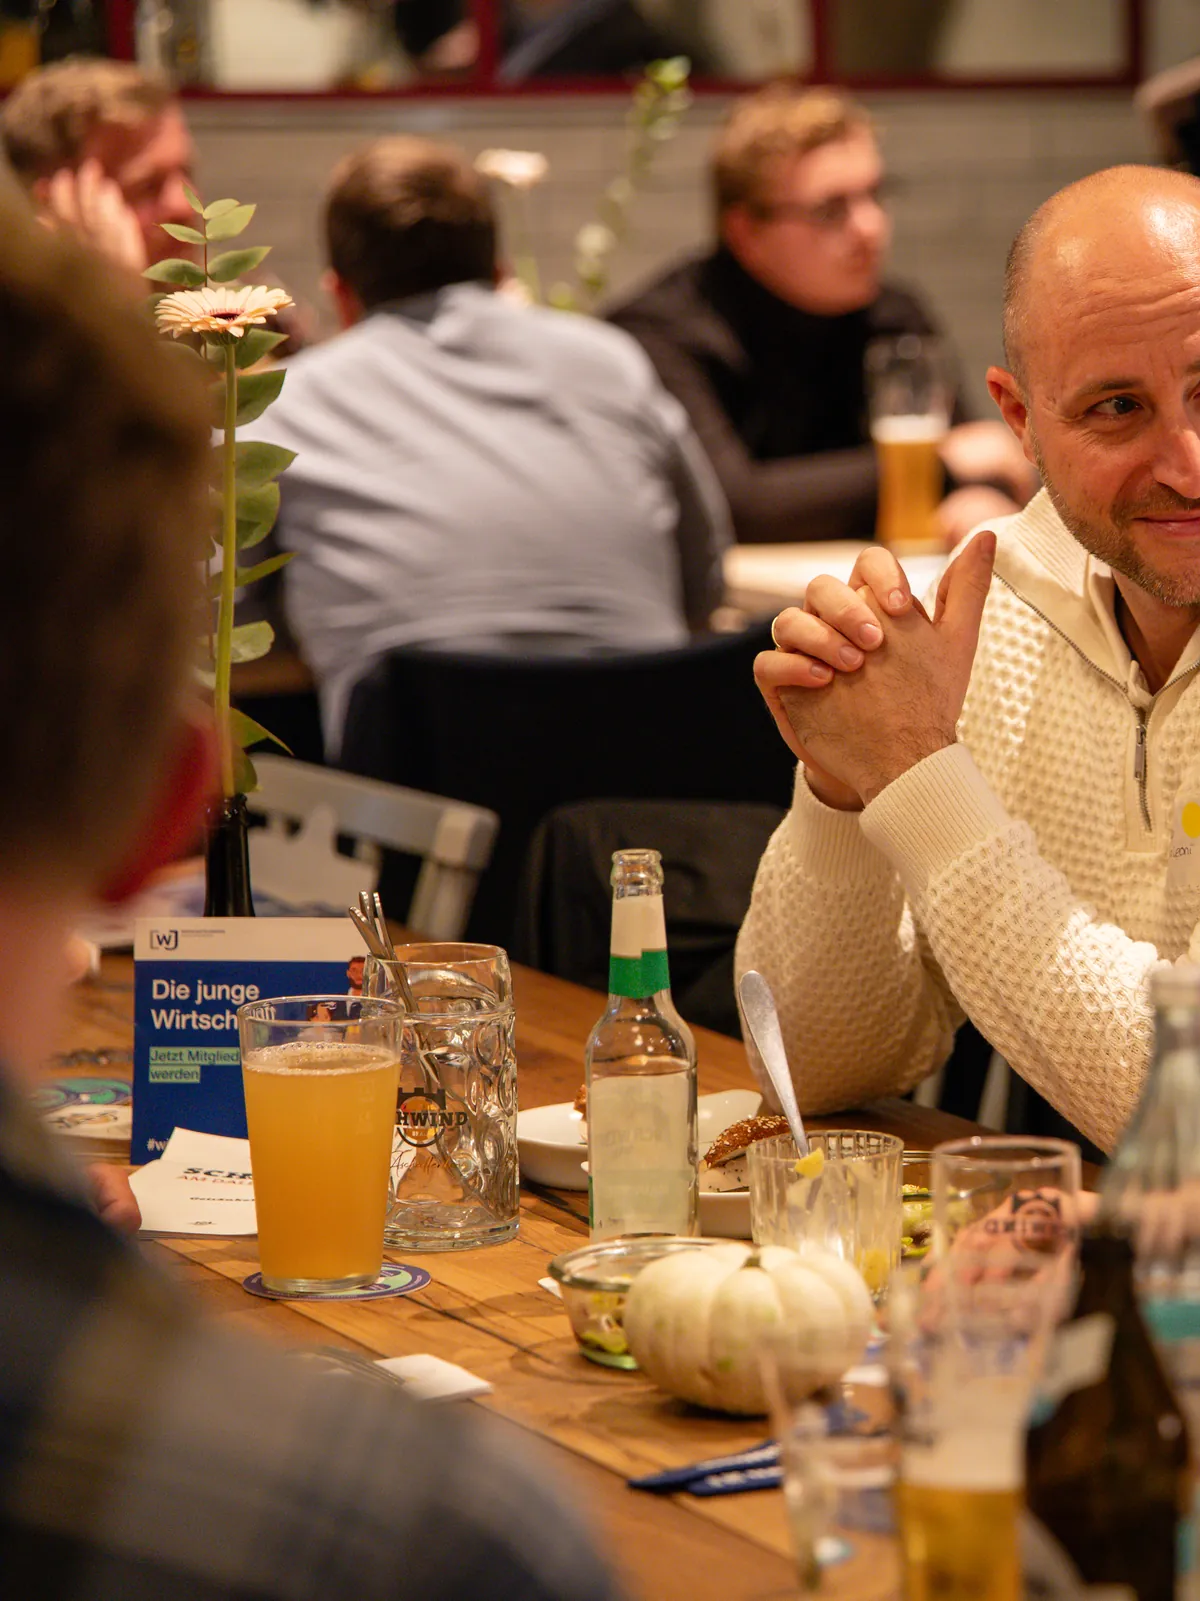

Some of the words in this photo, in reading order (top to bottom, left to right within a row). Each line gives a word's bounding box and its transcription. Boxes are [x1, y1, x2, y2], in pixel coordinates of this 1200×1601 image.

[152, 979, 191, 1000] Die
[195, 979, 260, 1005] junge
[151, 1050, 183, 1061] Jetzt
[187, 1050, 240, 1064] Mitglied
[150, 1068, 200, 1080] werden
